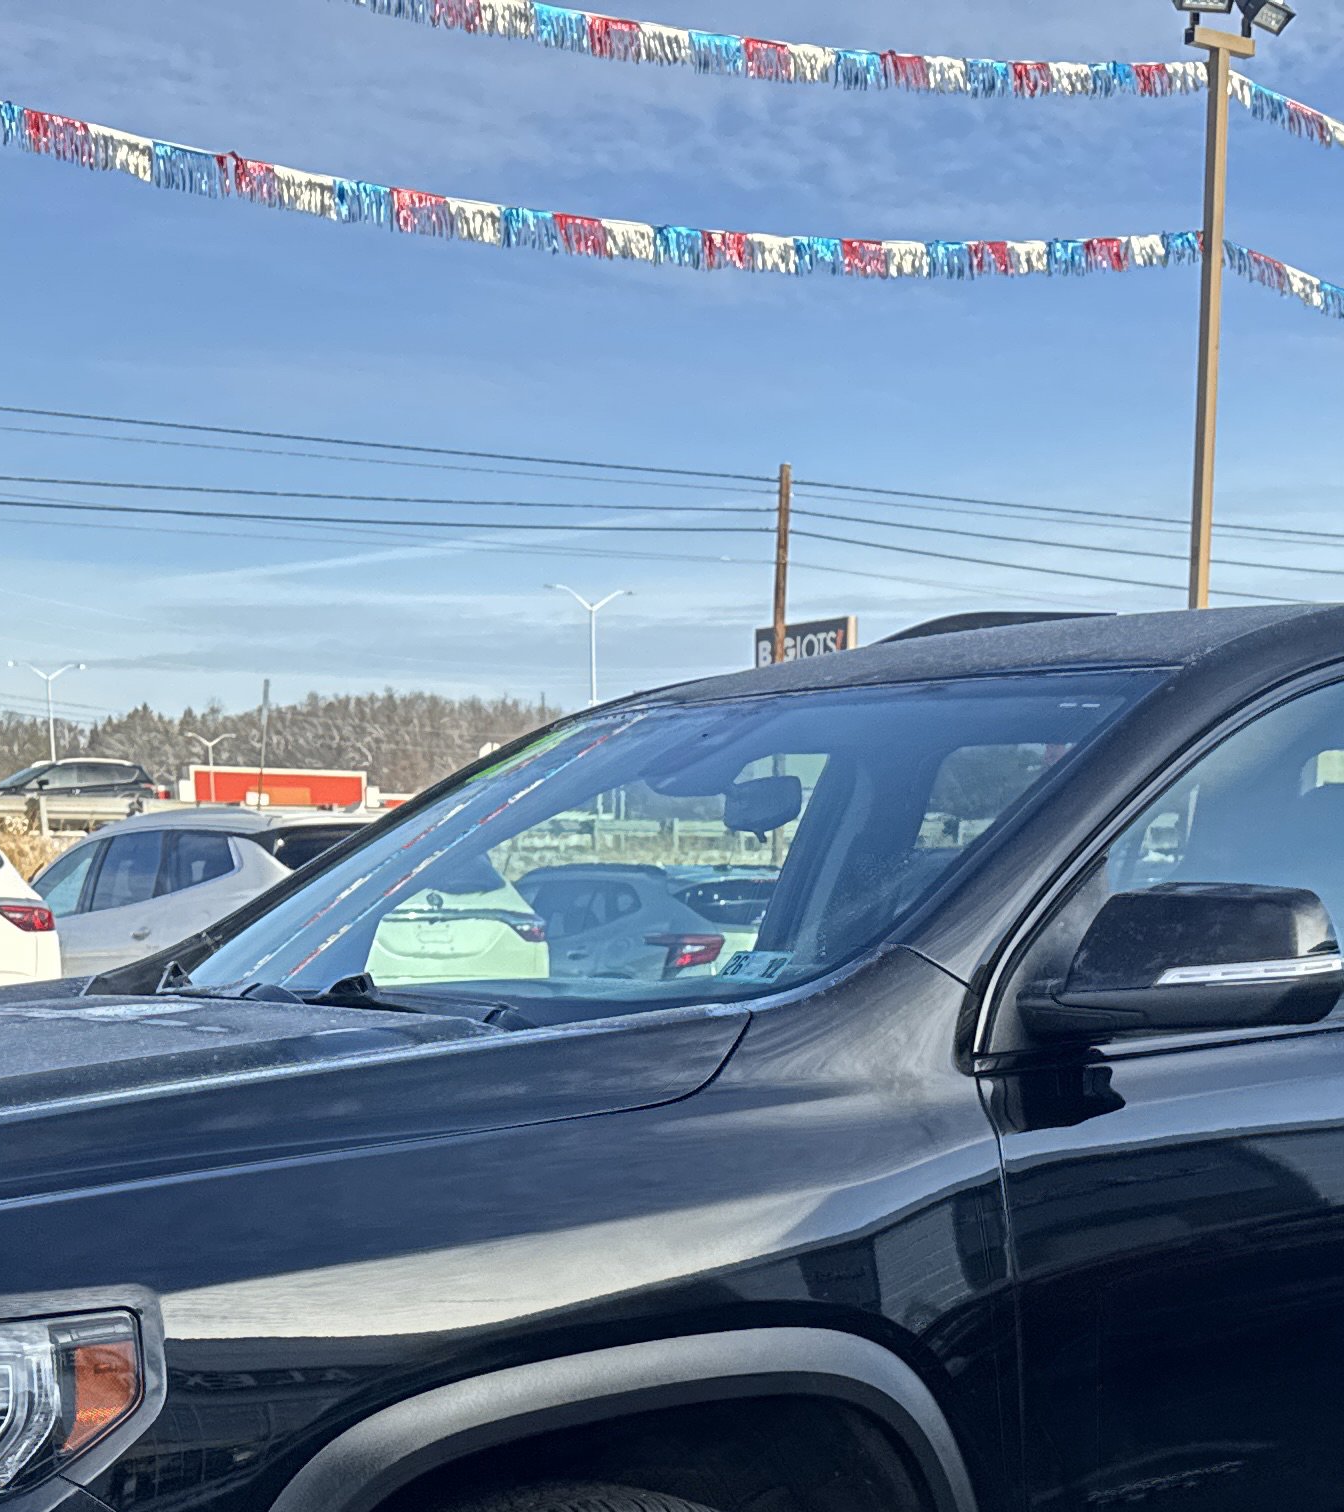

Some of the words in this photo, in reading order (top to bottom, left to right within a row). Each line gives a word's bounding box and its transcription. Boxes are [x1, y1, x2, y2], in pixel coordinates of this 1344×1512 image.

[758, 637, 796, 668] BG
[722, 954, 751, 976] 26
[760, 957, 788, 979] 12
